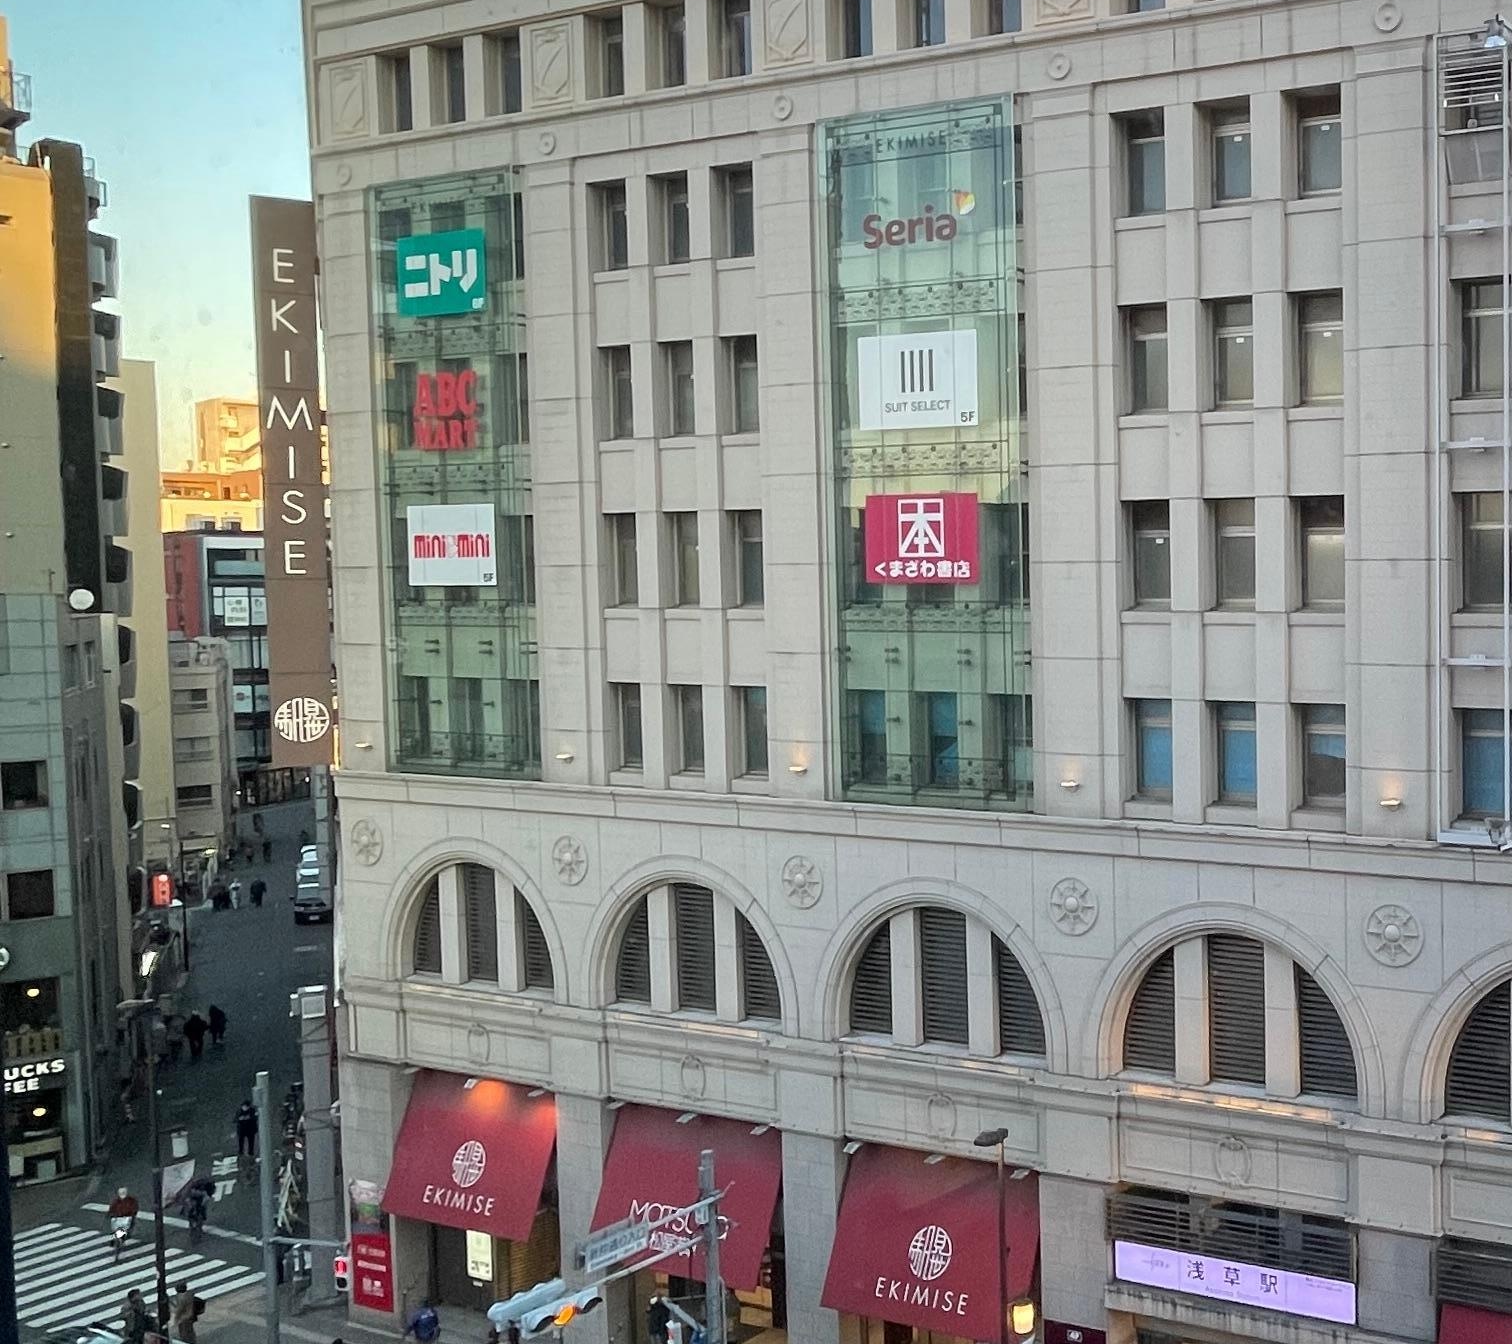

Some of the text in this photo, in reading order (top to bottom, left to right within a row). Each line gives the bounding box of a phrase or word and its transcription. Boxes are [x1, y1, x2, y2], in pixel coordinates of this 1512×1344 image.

[876, 130, 947, 153] EKIMISE
[863, 204, 958, 249] Seria
[405, 248, 477, 298] ニトリ
[415, 369, 477, 417] ABC
[884, 399, 951, 413] SUIT SELECT
[267, 248, 313, 576] EKIMISE
[960, 411, 975, 423] 5F
[414, 418, 478, 450] MART
[414, 534, 490, 558] mini mini
[874, 559, 971, 578] くまざわ書店
[422, 1184, 495, 1216] EKIMISE
[1186, 1258, 1279, 1296] 浅草駅
[875, 1276, 969, 1315] EKIMISE
